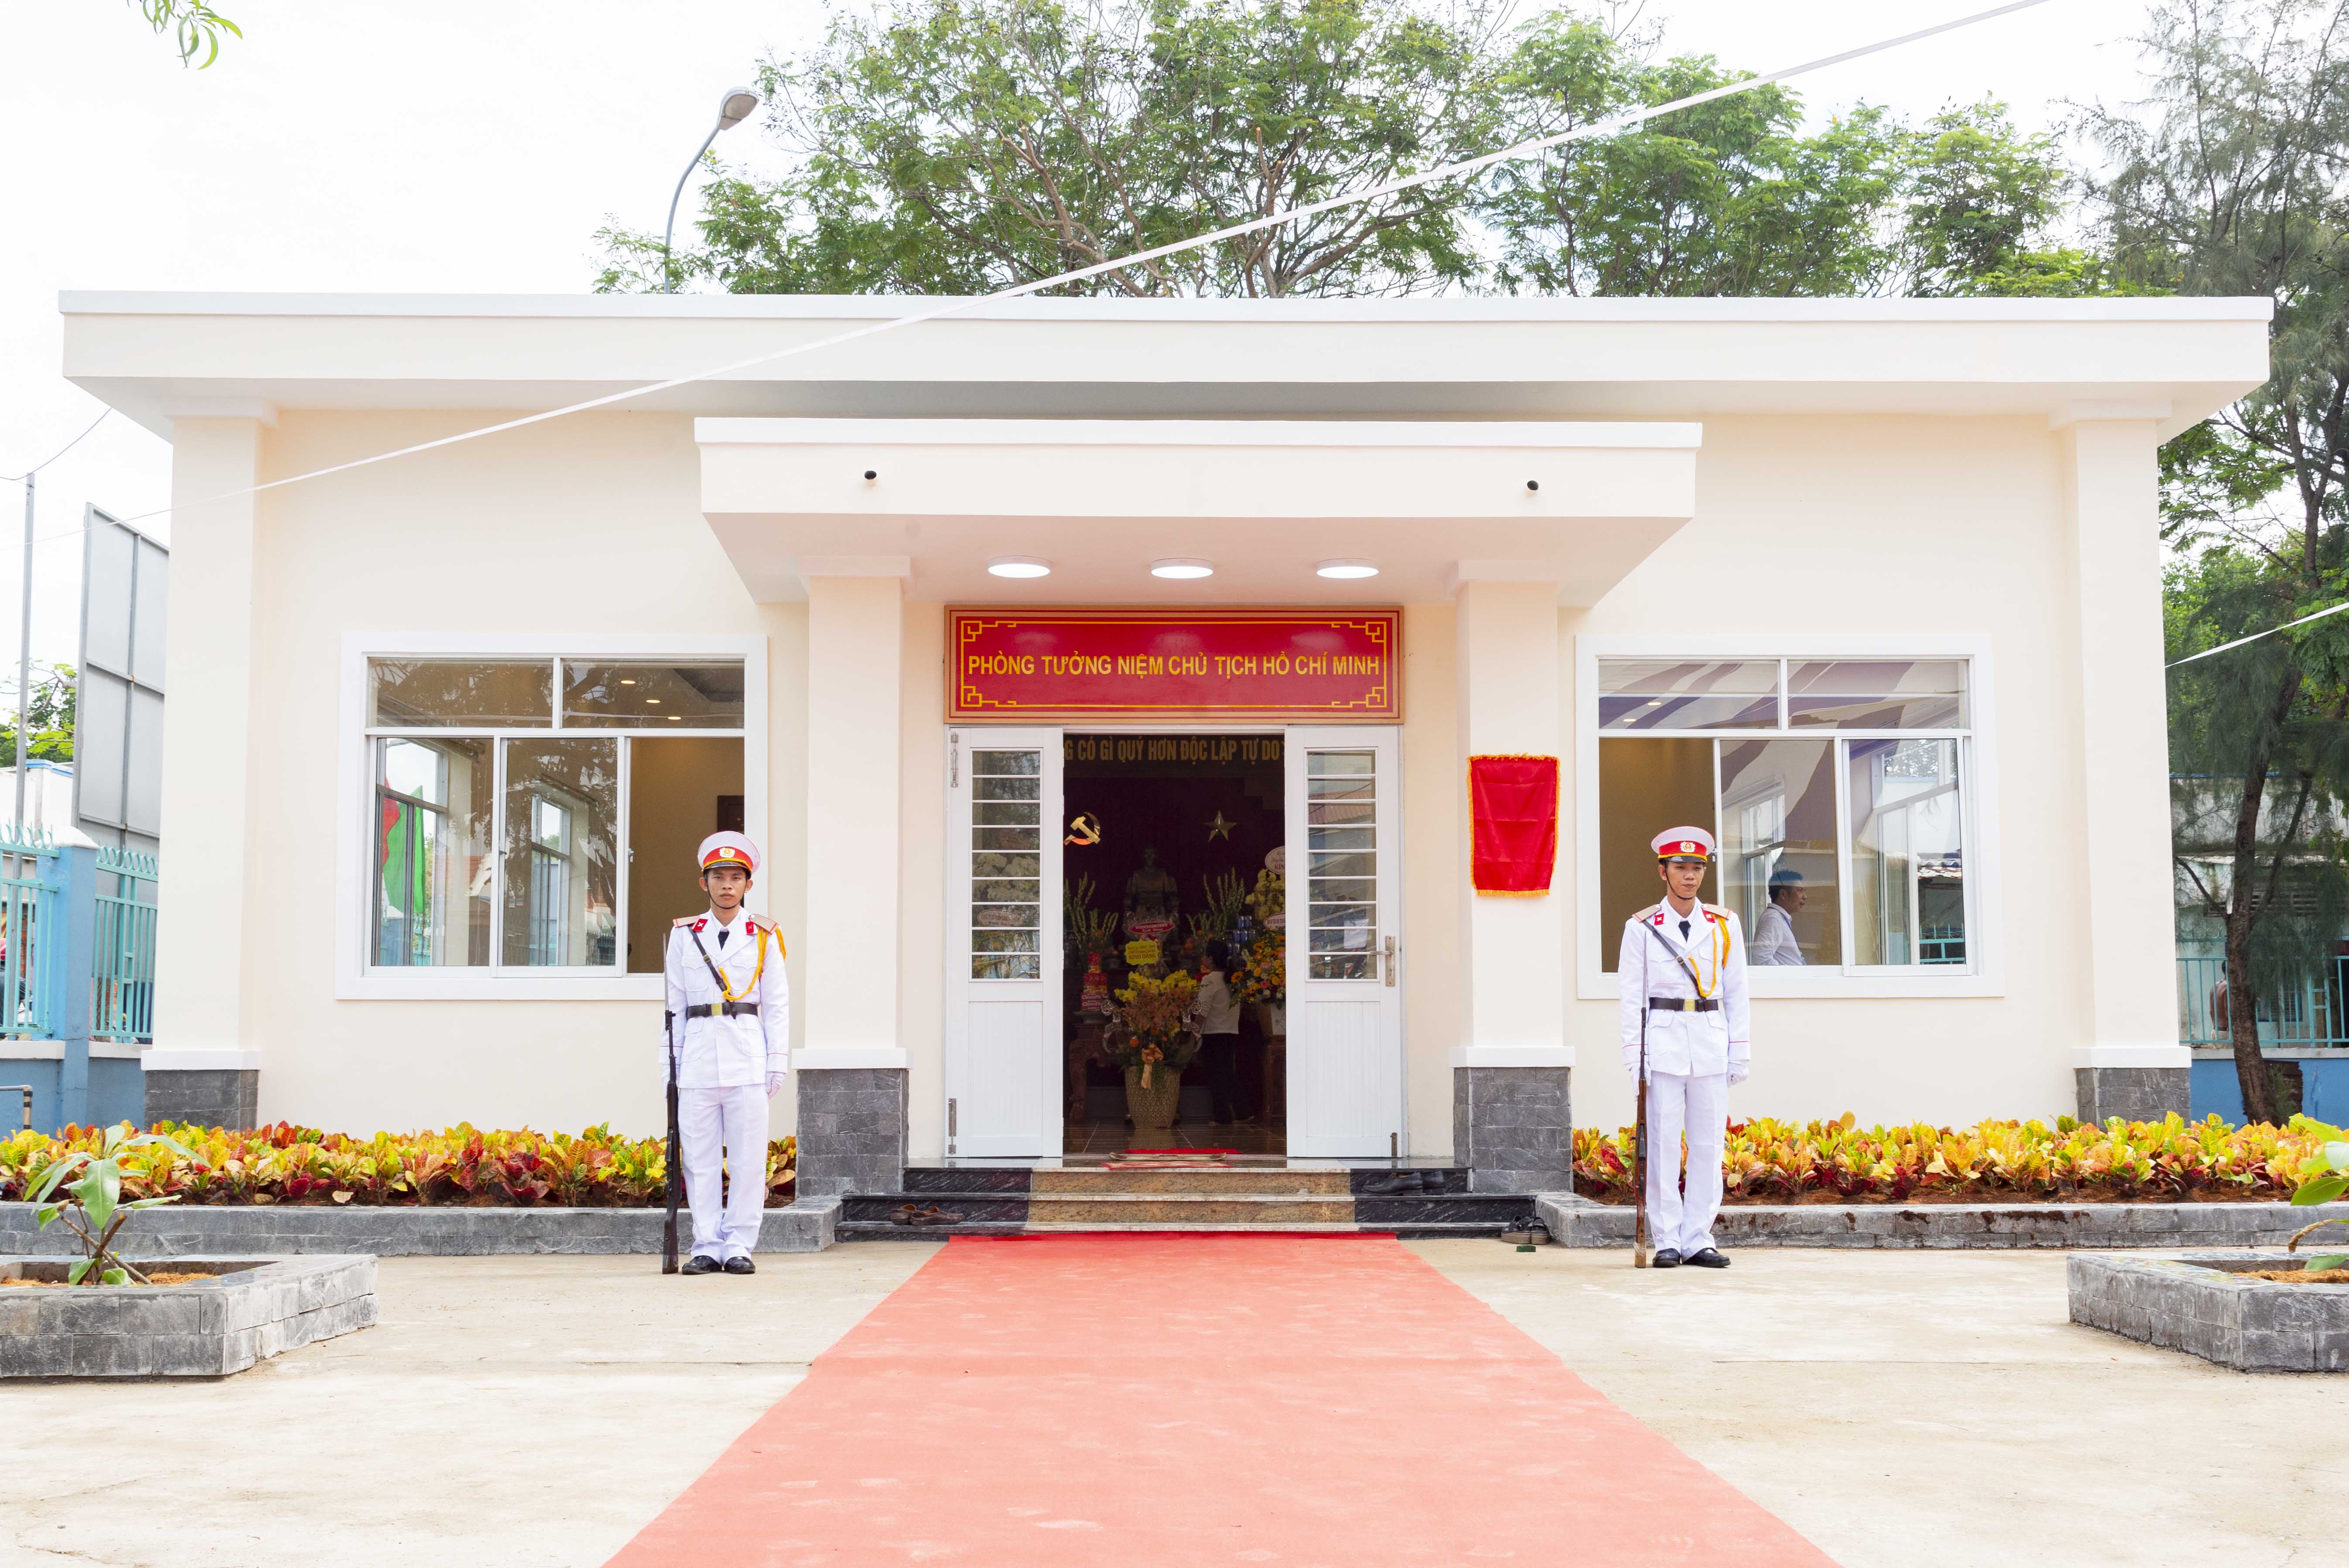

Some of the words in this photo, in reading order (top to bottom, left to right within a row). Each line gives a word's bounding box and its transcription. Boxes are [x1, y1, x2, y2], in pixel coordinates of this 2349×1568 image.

[968, 651, 1034, 675] PHÒNG
[1042, 650, 1111, 675] TƯỞNG
[1118, 655, 1163, 679] NIỆM
[1169, 652, 1207, 675] CHỦ
[1215, 656, 1256, 679] TỊCH
[1263, 652, 1289, 675] HỒ
[1296, 652, 1327, 675] CHÍ
[1333, 656, 1379, 675] MINH
[1078, 736, 1096, 760] CÓ
[1100, 736, 1113, 760] GÌ
[1118, 736, 1144, 763] QUÝ
[1149, 738, 1176, 760] HƠN
[1180, 736, 1208, 765] ĐỘC
[1211, 736, 1237, 765] LẬP
[1241, 738, 1259, 765] TỰ
